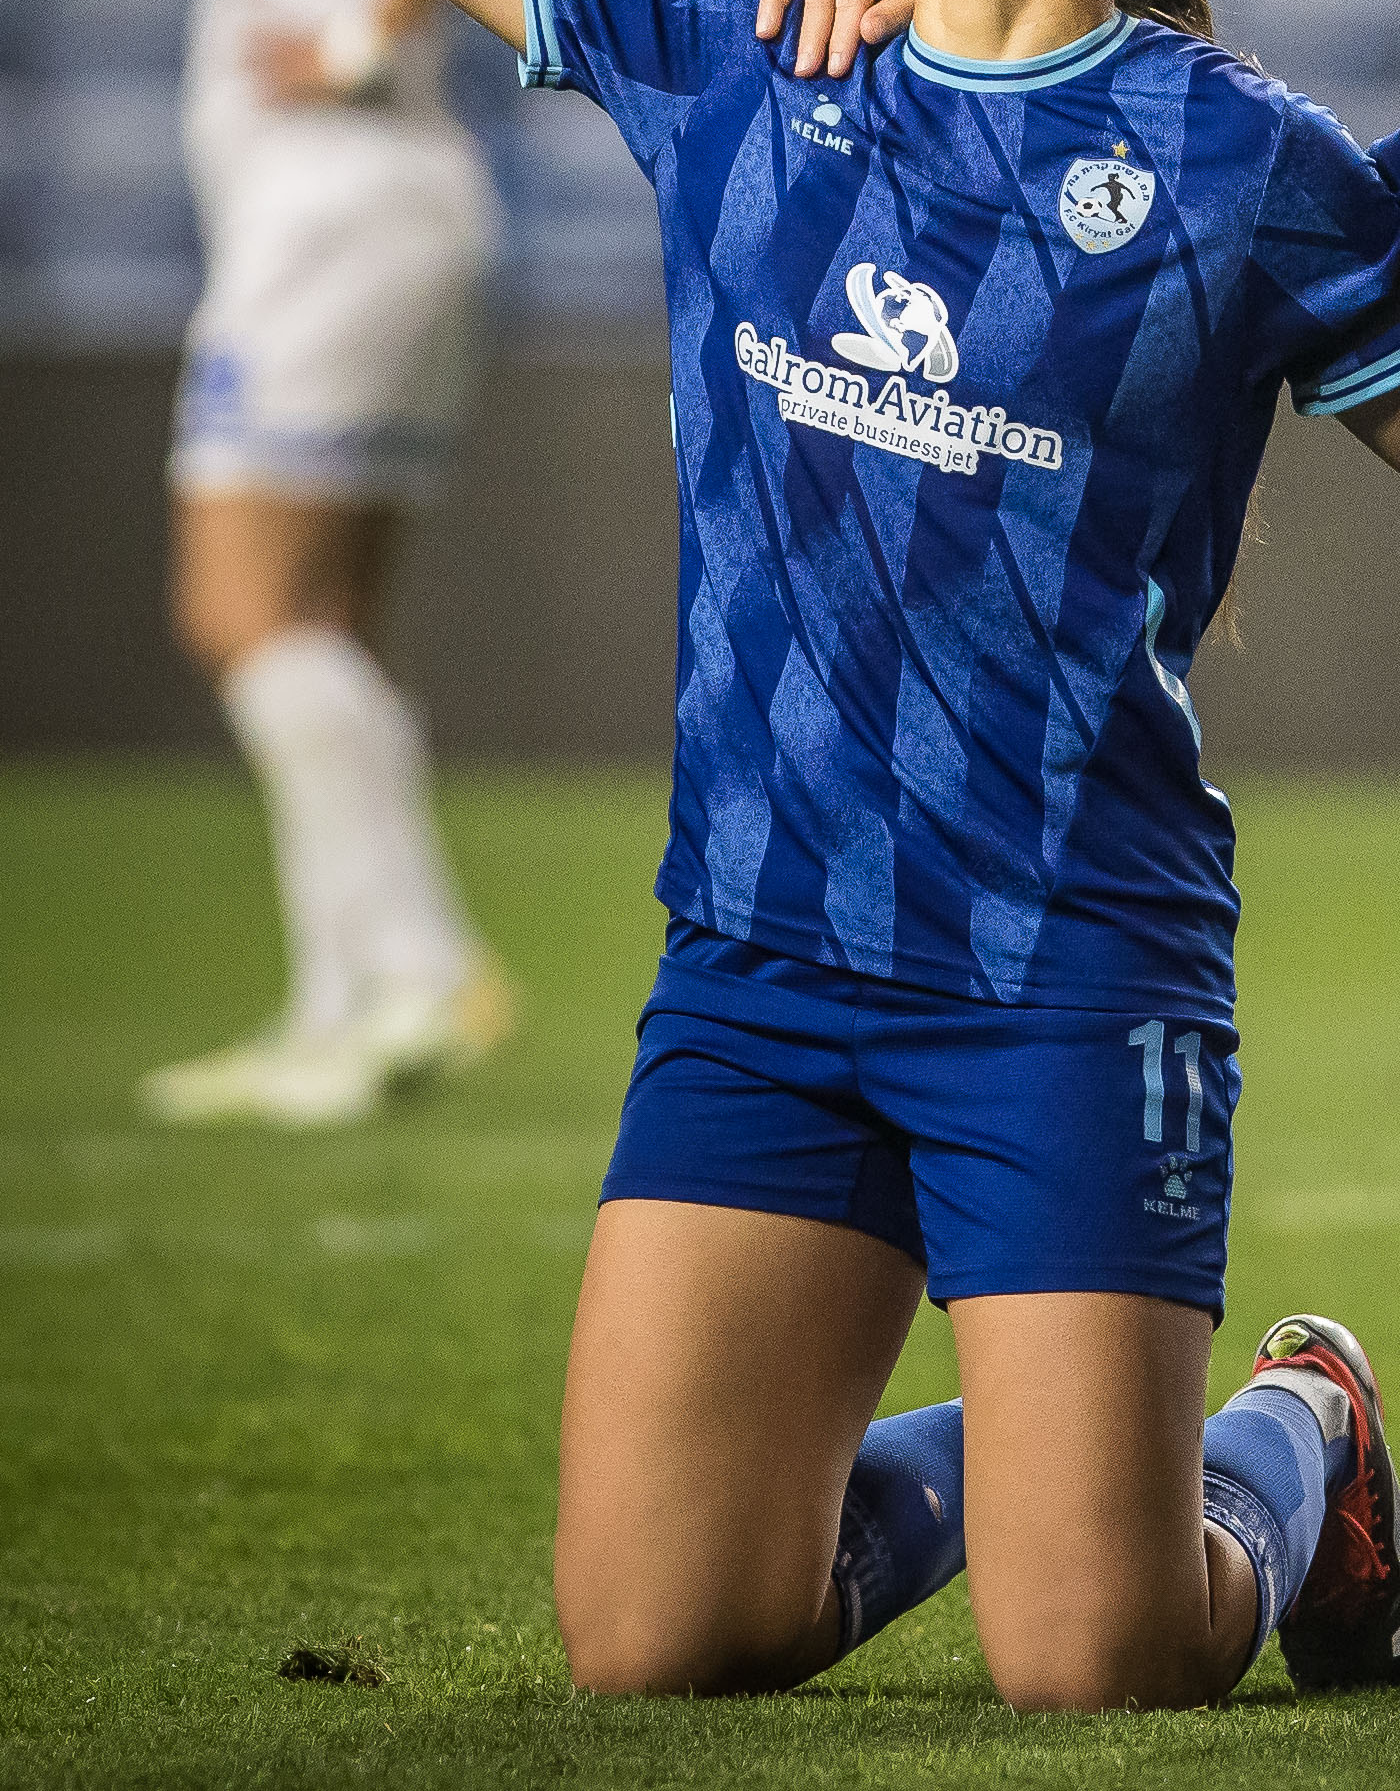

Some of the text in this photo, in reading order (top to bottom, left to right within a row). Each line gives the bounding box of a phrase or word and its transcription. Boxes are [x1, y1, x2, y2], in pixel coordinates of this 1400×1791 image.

[791, 116, 854, 156] KELME
[1077, 221, 1112, 238] Kiryat
[1115, 222, 1136, 236] Gat
[738, 326, 1058, 464] Galrom Aviation
[780, 397, 974, 471] private business jet
[1128, 1019, 1203, 1153] 11
[1144, 1198, 1200, 1221] KELME
